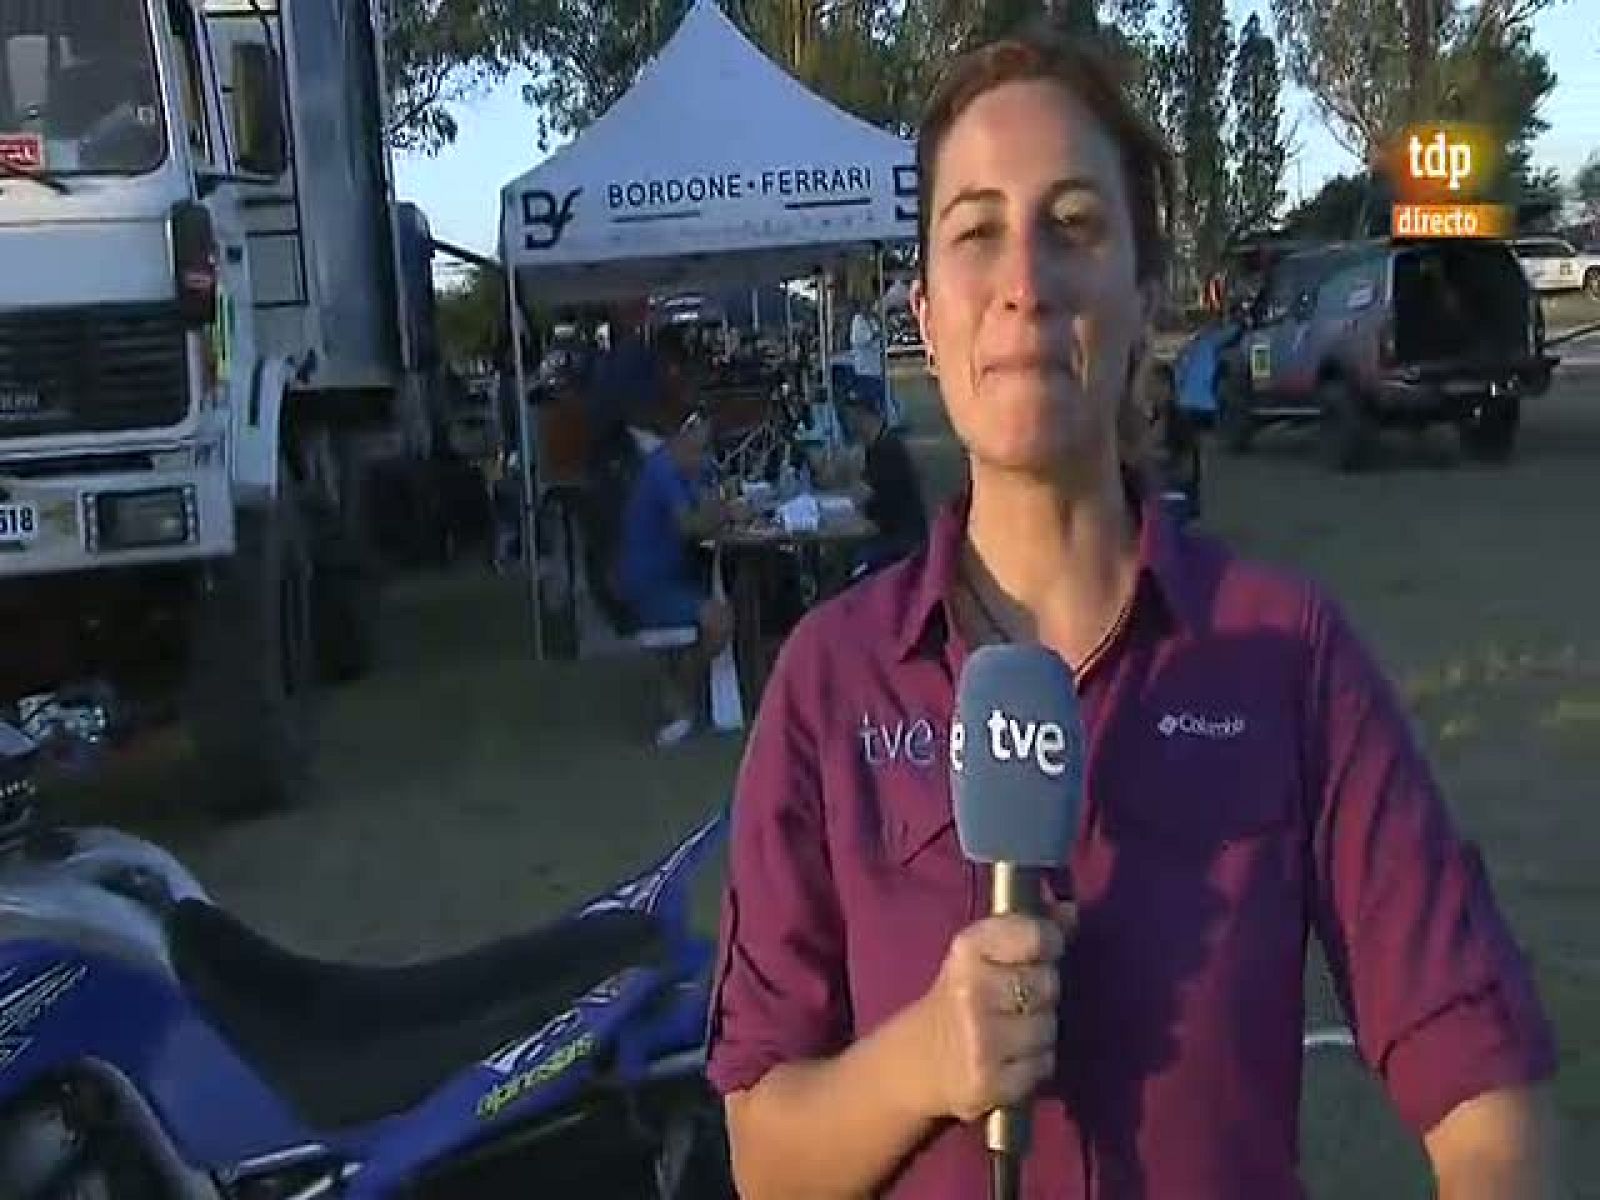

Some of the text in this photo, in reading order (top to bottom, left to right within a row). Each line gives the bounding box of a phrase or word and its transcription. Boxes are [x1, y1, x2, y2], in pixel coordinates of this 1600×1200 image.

[607, 166, 872, 208] BORDONE FERRARI
[859, 711, 936, 765] tve
[986, 708, 1066, 776] tve
